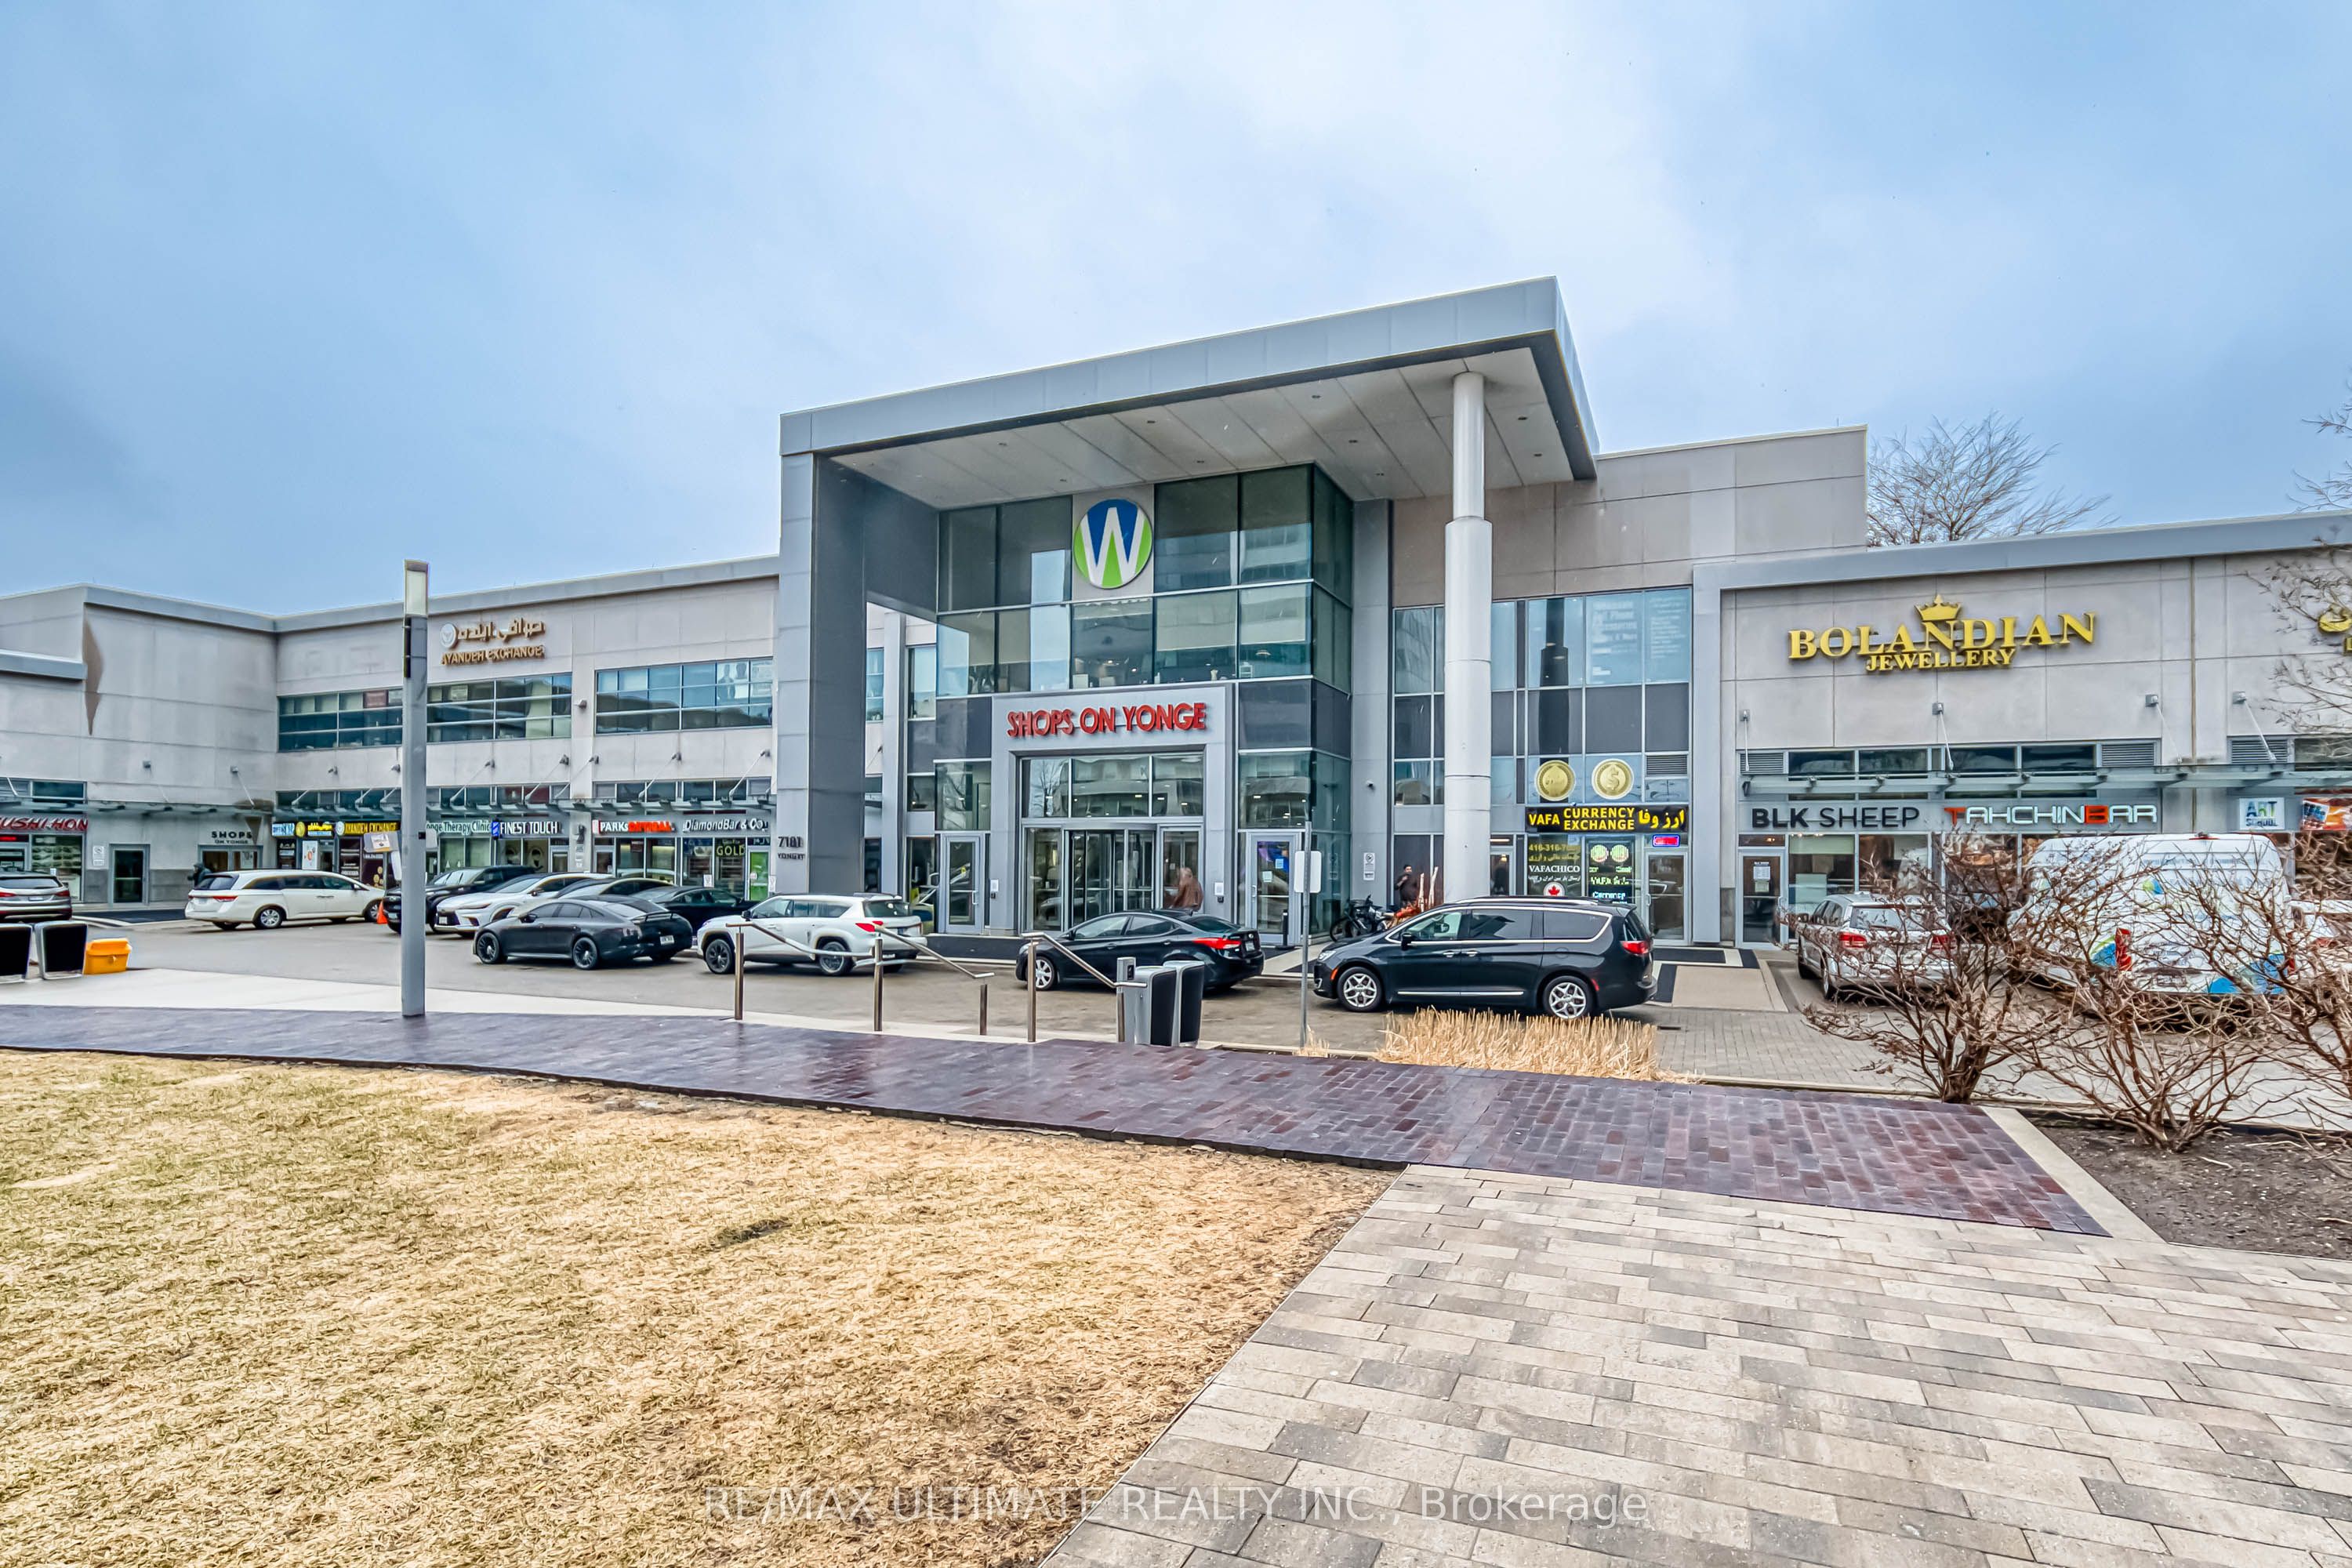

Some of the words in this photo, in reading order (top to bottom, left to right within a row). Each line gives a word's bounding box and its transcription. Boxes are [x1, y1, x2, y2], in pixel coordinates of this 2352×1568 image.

[1788, 613, 2096, 659] BOLANDIAN
[1866, 648, 2016, 671] JEWELLERY
[1007, 709, 1074, 737] SHOPS
[1080, 707, 1116, 735] ON
[1123, 702, 1206, 731] YONGE
[1563, 807, 1635, 818] CURRENCY
[1751, 808, 1809, 829] BLK
[1819, 807, 1920, 828] SHEEP
[0, 817, 48, 829] USHI
[1529, 814, 1560, 826] VAFA
[1563, 819, 1635, 830] EXCHANGE
[444, 822, 470, 835] Therapy
[471, 820, 492, 833] Clinic
[500, 822, 526, 834] FINEST
[528, 821, 557, 834] TOUCH
[716, 845, 746, 856] GOLD
